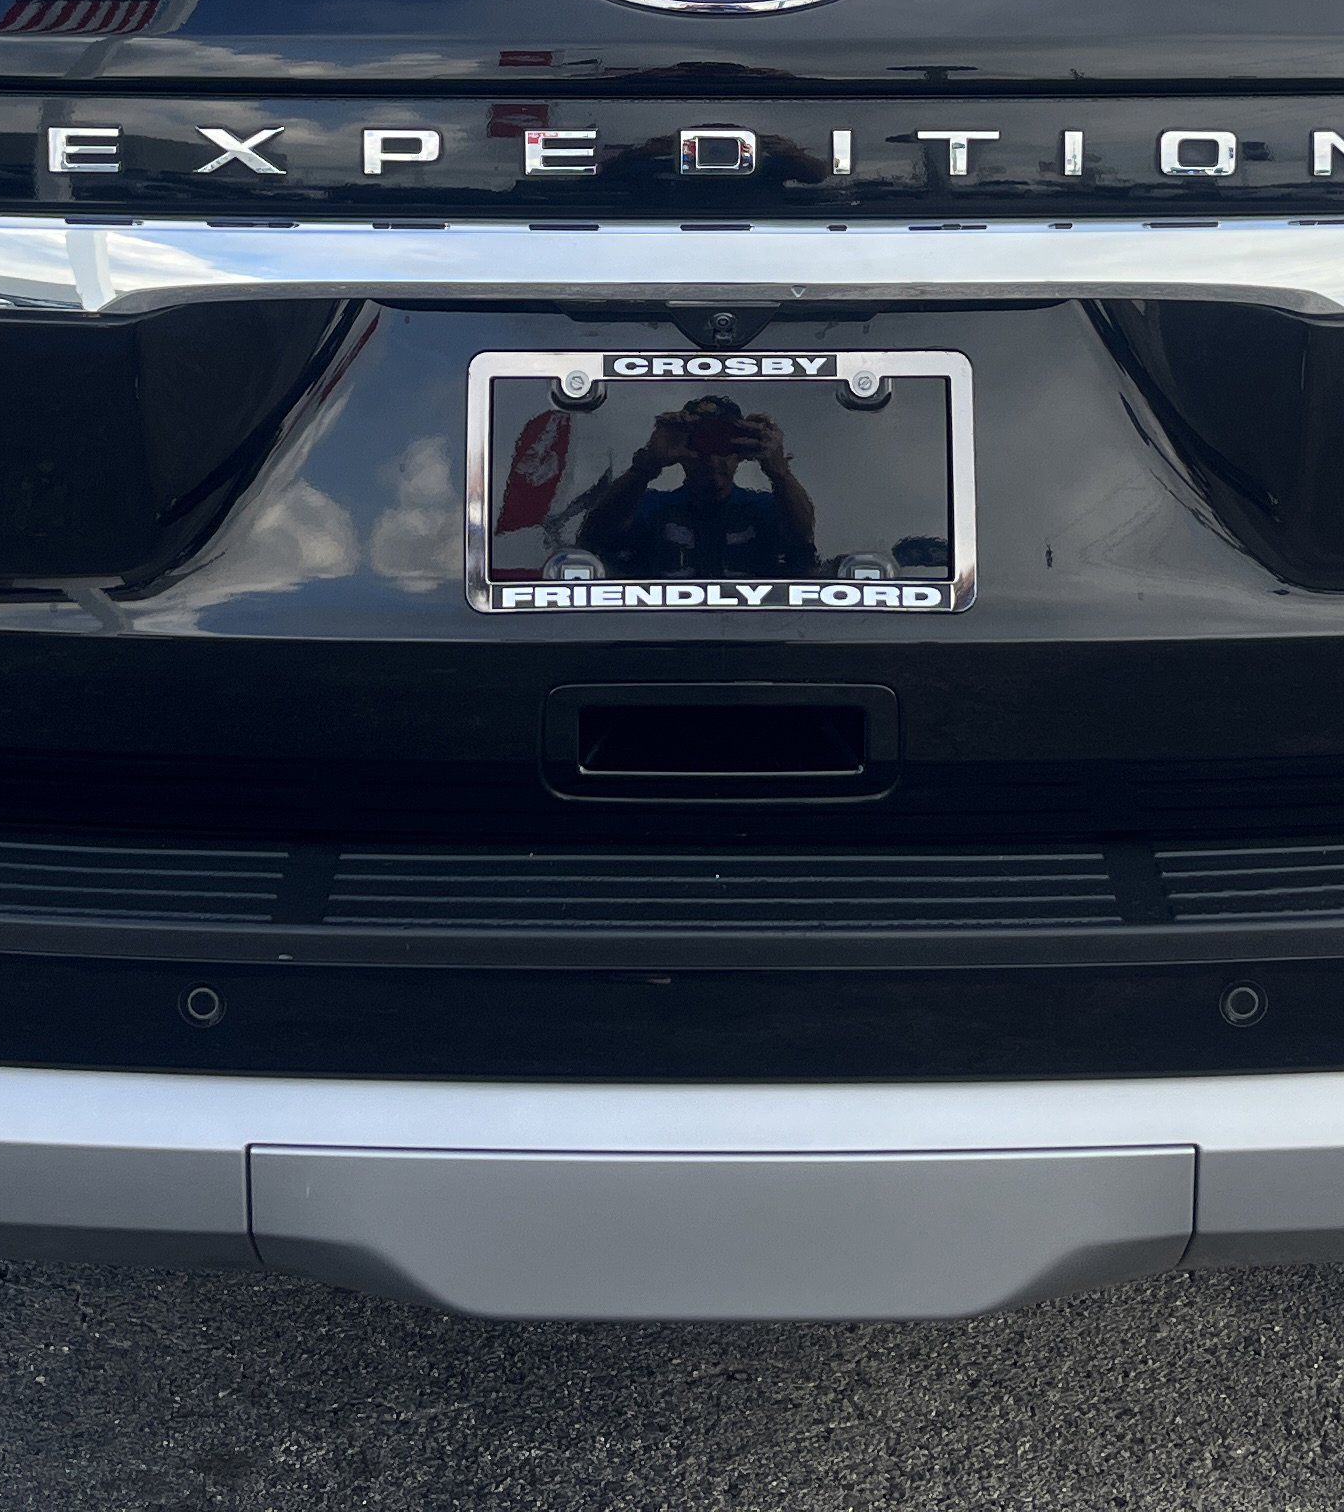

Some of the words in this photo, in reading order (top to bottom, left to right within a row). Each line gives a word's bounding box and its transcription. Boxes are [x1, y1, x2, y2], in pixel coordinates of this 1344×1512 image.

[613, 357, 829, 375] CROSBY
[501, 584, 776, 607] FRIENDLY
[789, 585, 943, 607] FORD
